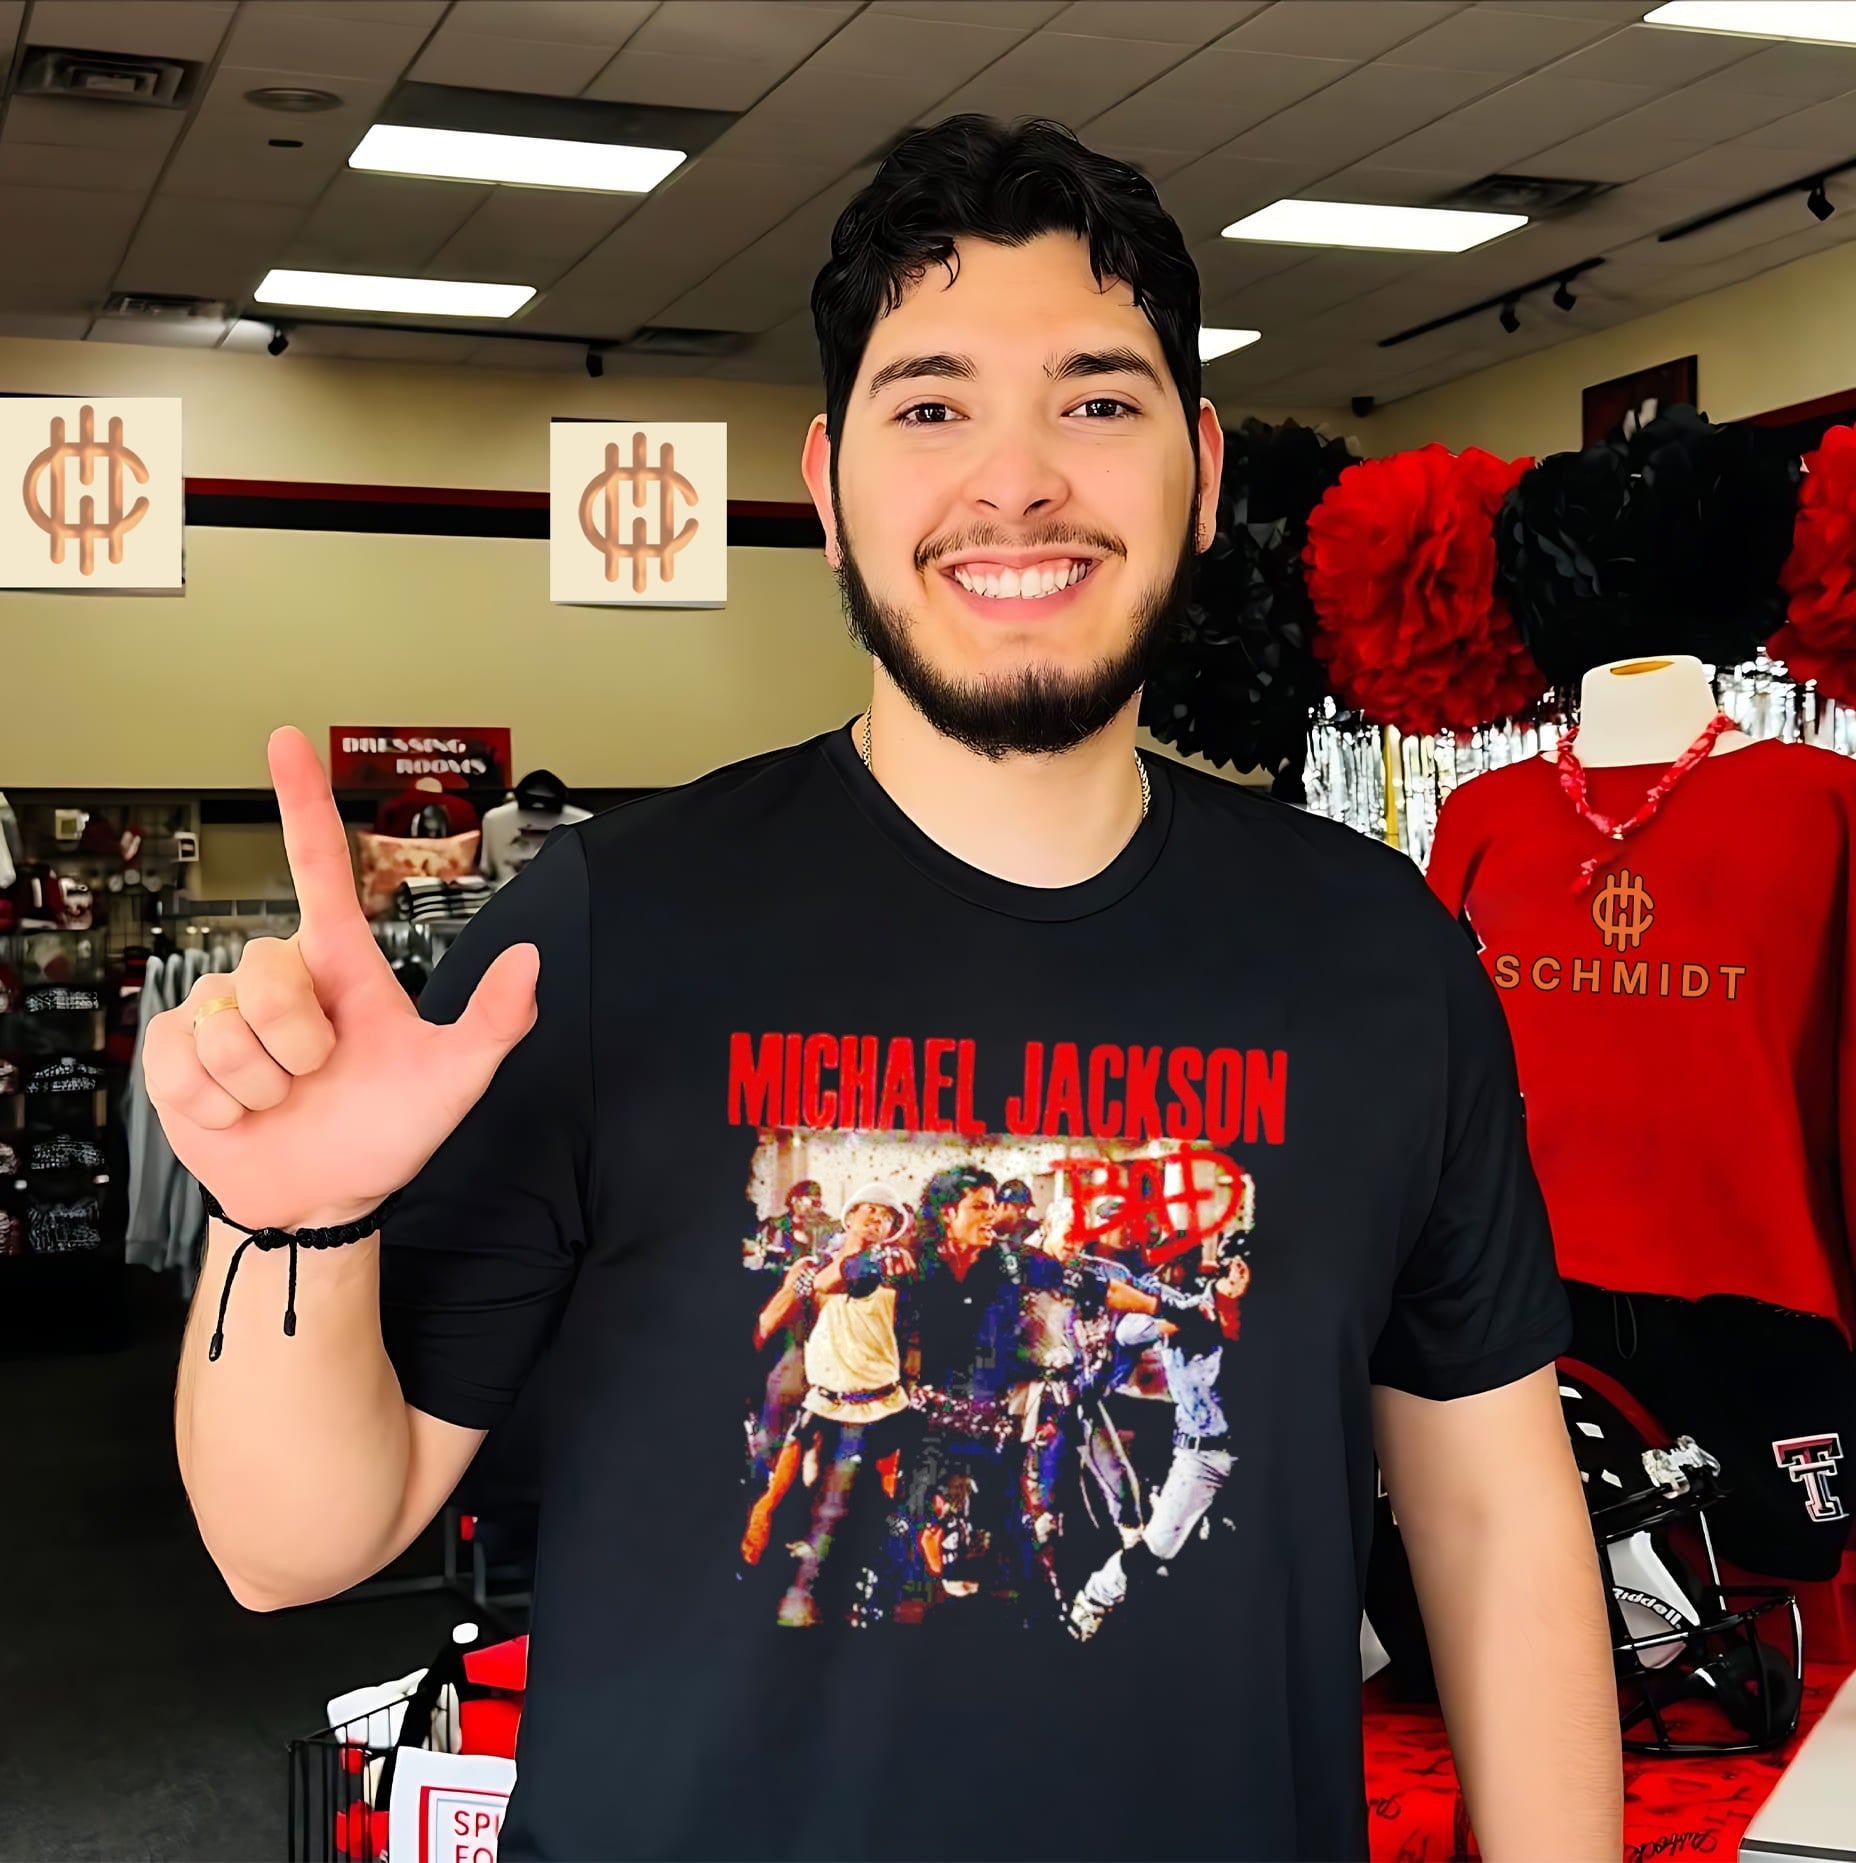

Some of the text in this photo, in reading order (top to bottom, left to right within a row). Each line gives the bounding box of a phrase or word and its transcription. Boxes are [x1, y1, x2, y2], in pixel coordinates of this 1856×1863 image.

[396, 758, 487, 775] ROOMS
[1493, 953, 1746, 1000] SCHMIDT
[727, 1032, 1288, 1146] MICHAEL JACKSON
[1049, 1143, 1245, 1264] BAD
